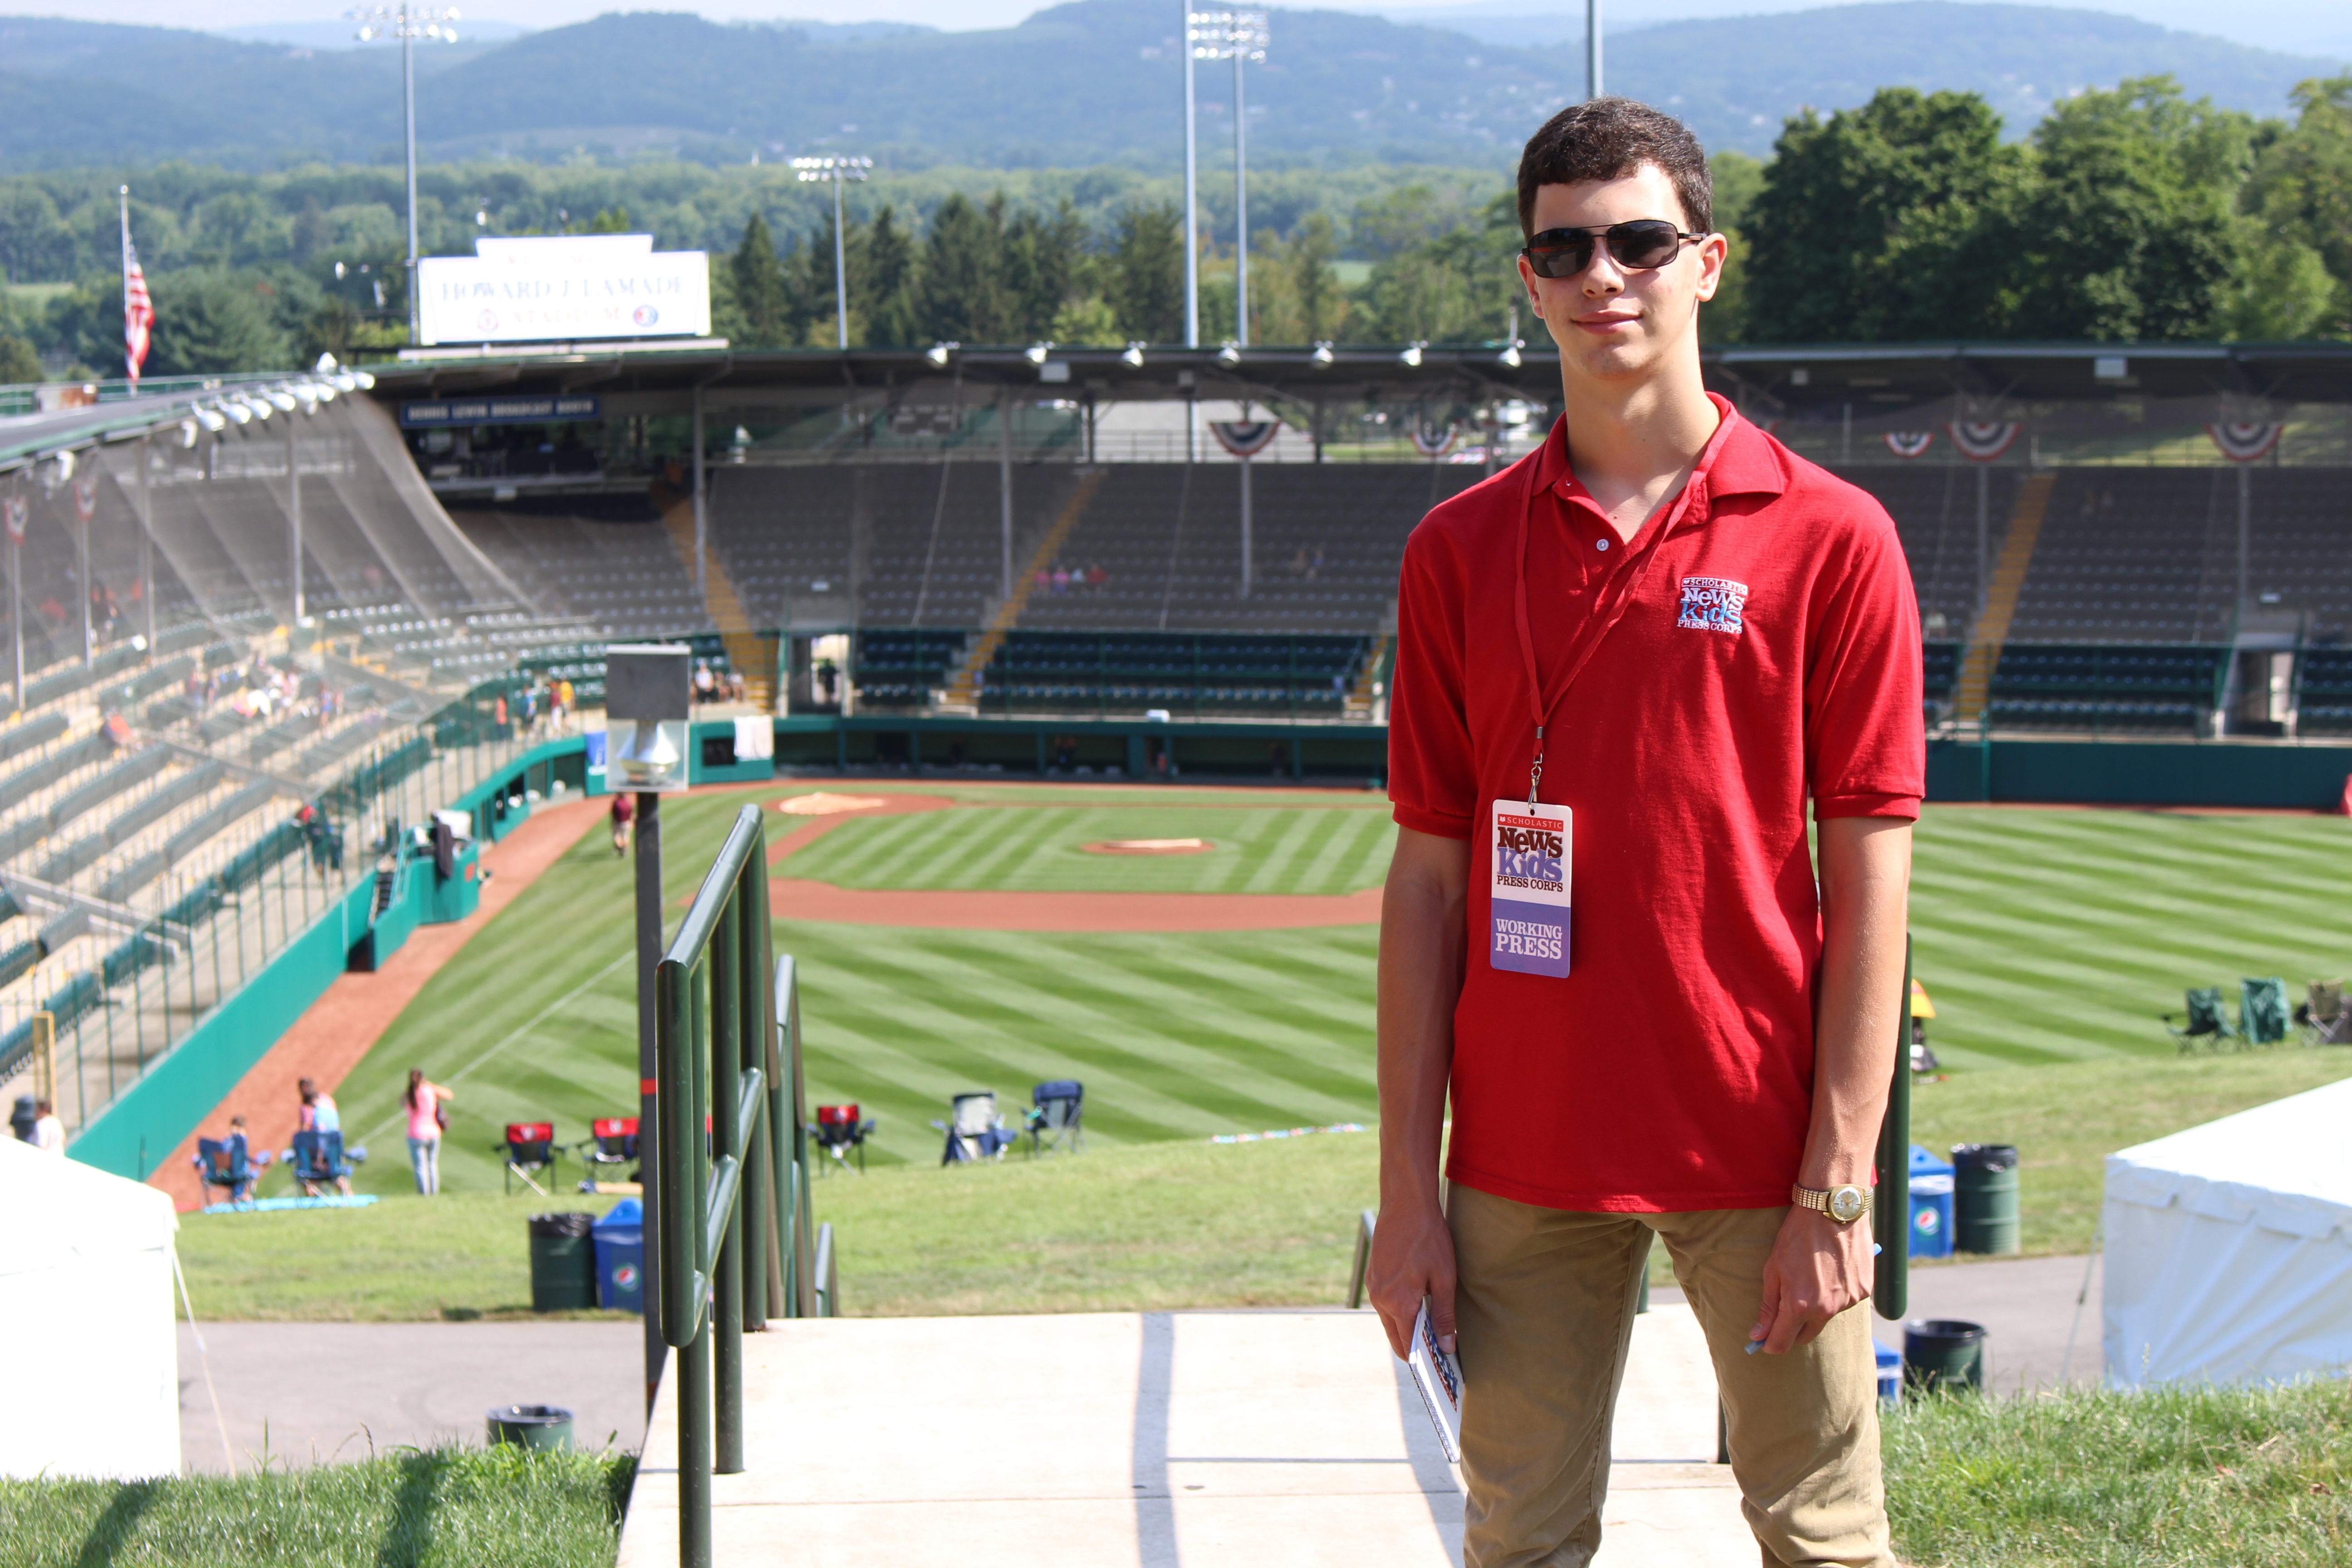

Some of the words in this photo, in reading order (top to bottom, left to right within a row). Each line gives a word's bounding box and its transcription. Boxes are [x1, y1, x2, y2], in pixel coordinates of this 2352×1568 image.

[442, 281, 551, 301] HOWARD
[1690, 579, 1747, 593] SCHOLASTIC
[1678, 601, 1742, 627] Kids
[1677, 619, 1709, 630] PRESS
[1710, 622, 1743, 634] CORPS
[1507, 817, 1562, 829] SCHOLASTIC
[1497, 847, 1563, 882] Kids
[1497, 875, 1529, 888] PRESS
[1530, 879, 1563, 892] CORPS
[1496, 918, 1563, 940] WORKING
[1495, 932, 1562, 960] PRESS
